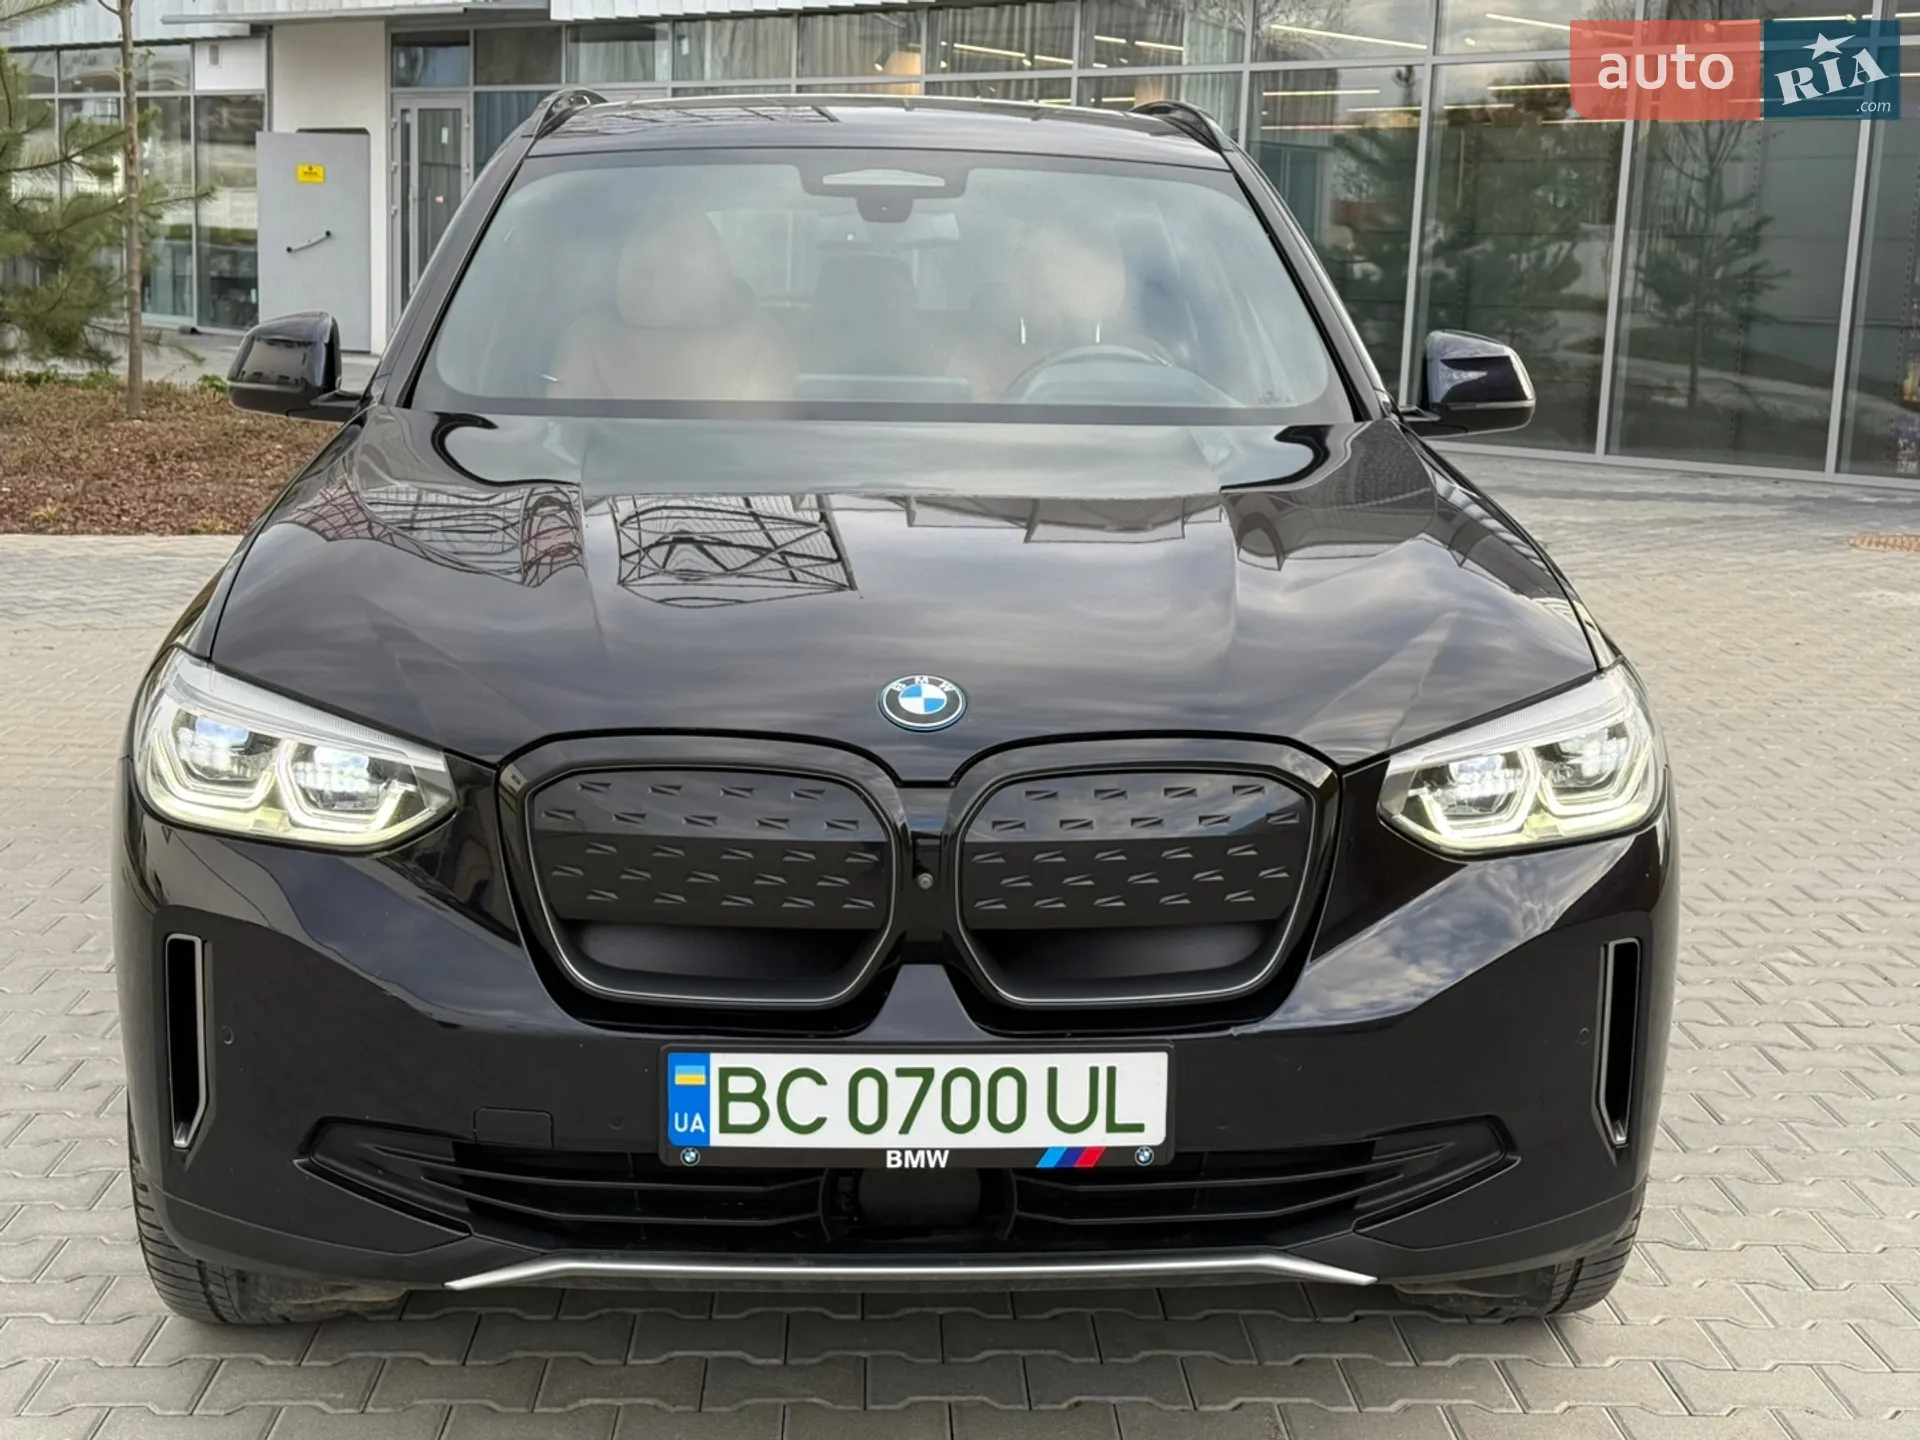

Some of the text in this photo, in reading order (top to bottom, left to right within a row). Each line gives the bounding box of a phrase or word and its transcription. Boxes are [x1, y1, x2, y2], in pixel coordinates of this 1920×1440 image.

[718, 1065, 1145, 1135] BC 0700 UL
[674, 1113, 706, 1133] UA
[885, 1149, 950, 1169] BMW
